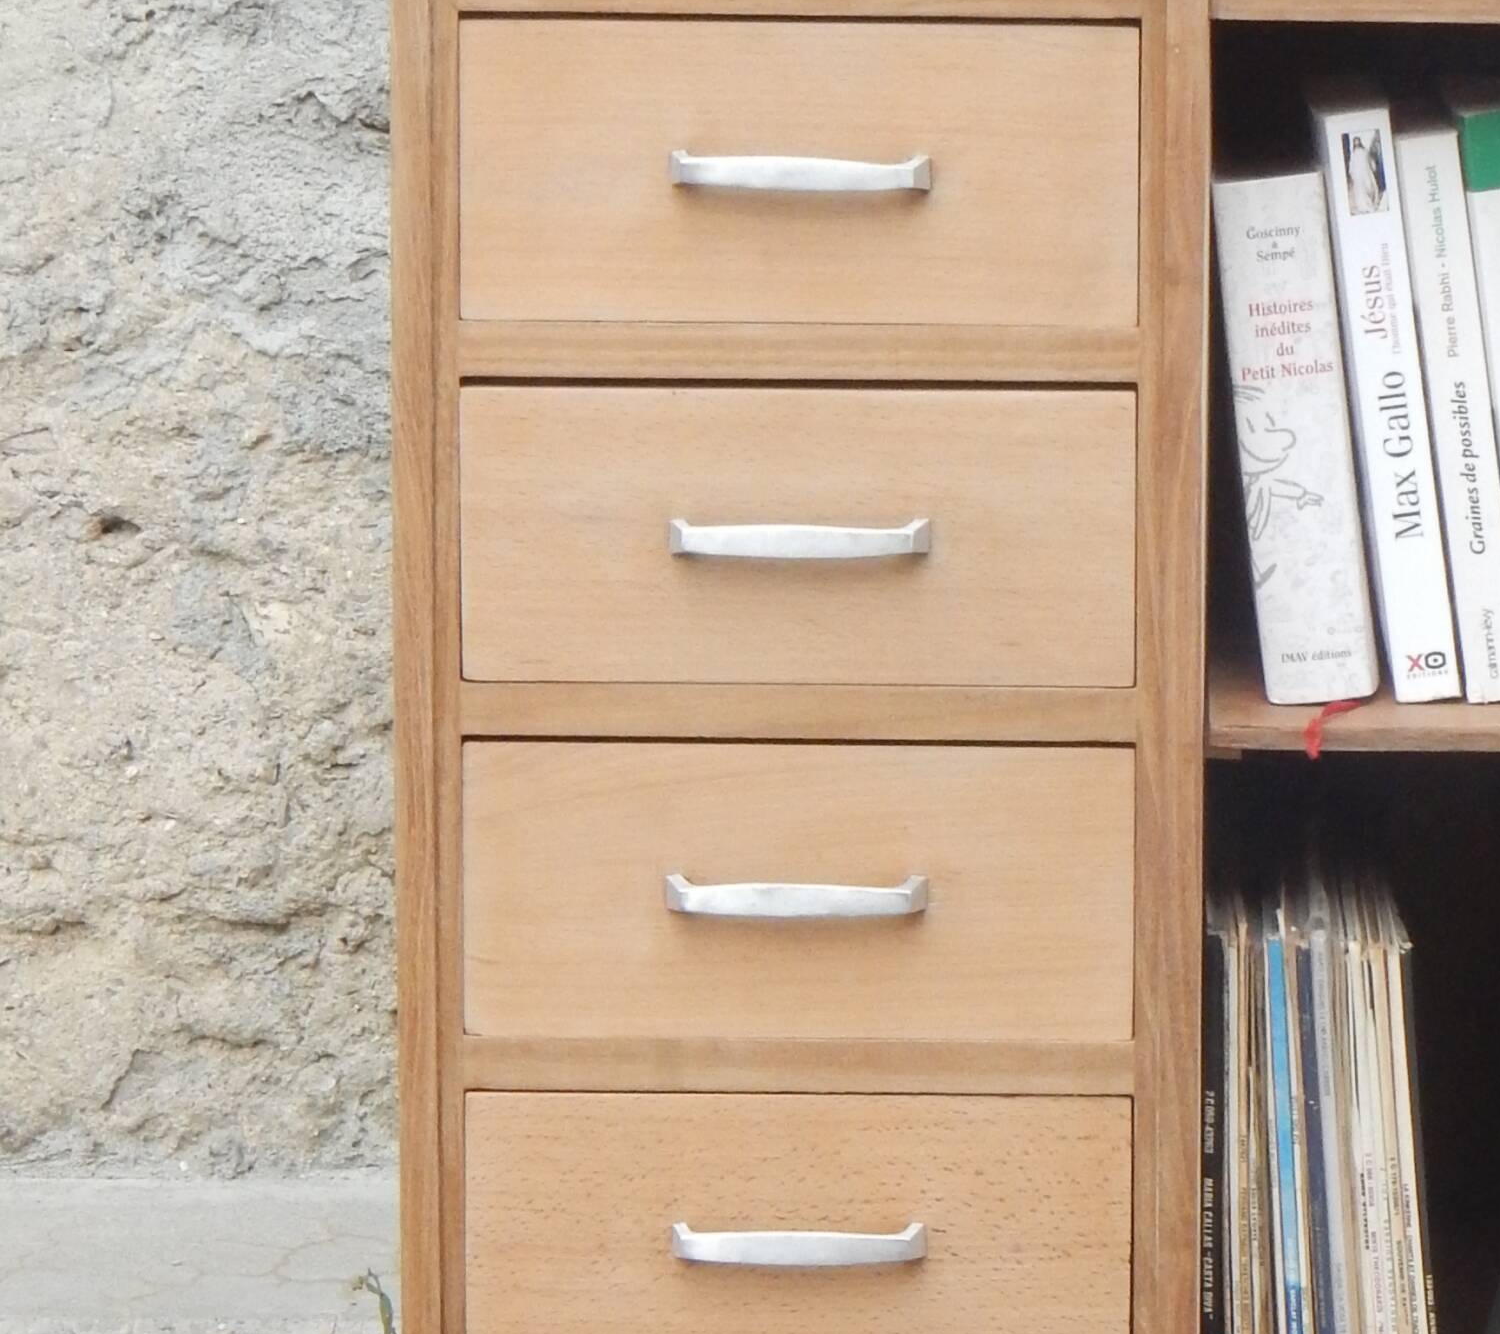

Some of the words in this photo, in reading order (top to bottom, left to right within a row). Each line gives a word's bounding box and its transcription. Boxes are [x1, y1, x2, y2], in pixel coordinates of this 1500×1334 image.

[1424, 165, 1442, 203] Hulot
[1246, 225, 1301, 240] Goscinny
[1431, 206, 1447, 259] Nicolas
[1256, 246, 1295, 262] Sempé
[1248, 299, 1314, 318] Histoires
[1360, 265, 1388, 339] Jésus
[1440, 272, 1454, 312] Rabhi
[1255, 321, 1312, 338] inédites
[1447, 317, 1460, 358] Pierre
[1276, 343, 1294, 357] du
[1241, 364, 1276, 381] Petit
[1281, 359, 1334, 378] Nicolas
[1377, 371, 1414, 458] Gallo
[1450, 381, 1479, 458] possibles
[1460, 463, 1478, 484] de
[1392, 467, 1424, 540] Max
[1465, 486, 1486, 555] Graines
[1311, 649, 1352, 661] éditions
[1203, 1177, 1214, 1207] MARIA
[1203, 1211, 1214, 1248] CALLAS
